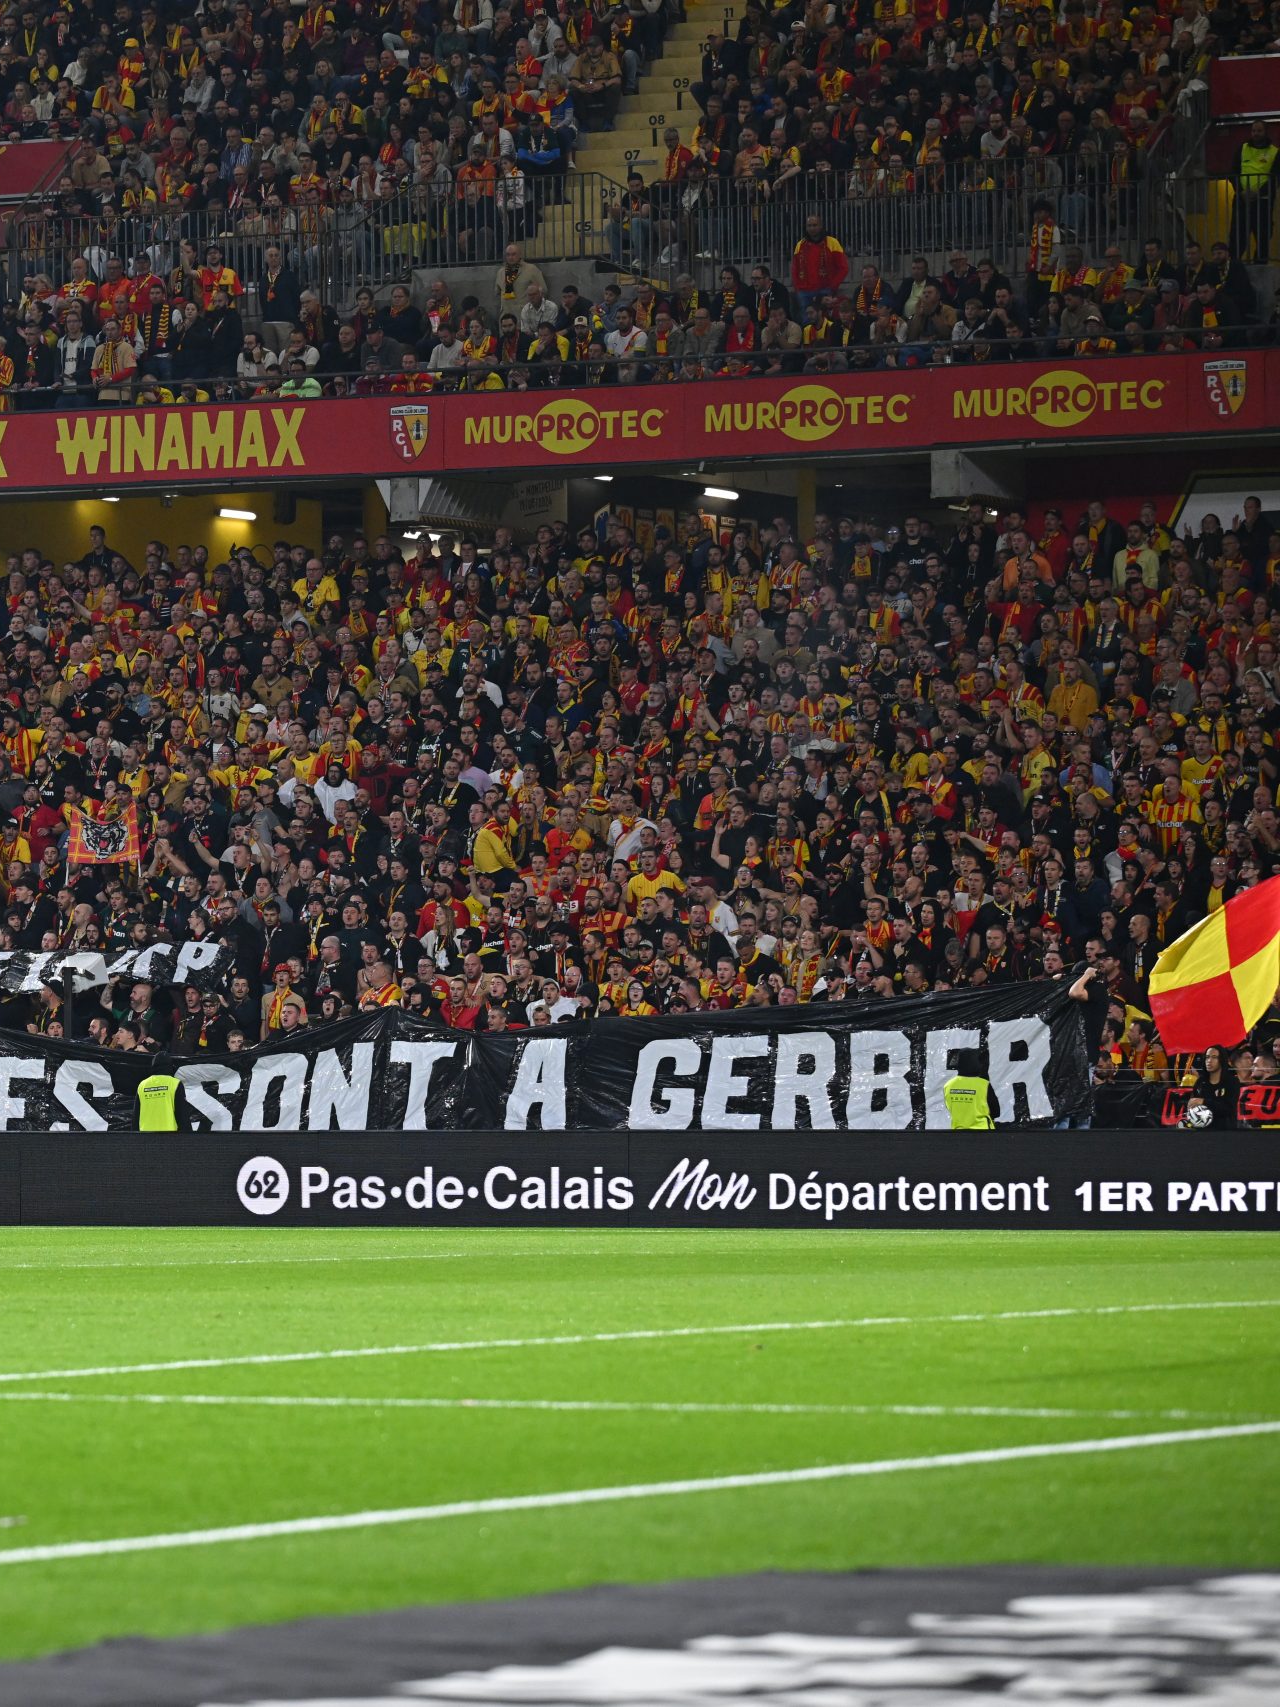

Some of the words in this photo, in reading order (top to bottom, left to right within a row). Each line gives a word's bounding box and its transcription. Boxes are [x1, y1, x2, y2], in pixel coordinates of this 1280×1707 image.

[724, 8, 734, 17] 11
[673, 78, 689, 88] 09
[649, 115, 665, 125] 08
[624, 150, 640, 161] 07
[705, 393, 912, 433] MURPROTEC
[953, 379, 1166, 418] MURPROTEC
[56, 408, 306, 475] WINAMAX
[464, 408, 664, 445] MURPROTEC
[174, 1041, 458, 1131] SONT
[503, 1038, 568, 1131] A
[244, 1169, 281, 1199] 62
[648, 1156, 758, 1211] Mon
[770, 1171, 1050, 1220] Département
[1075, 1180, 1154, 1213] 1ER
[1168, 1180, 1280, 1213] PART
